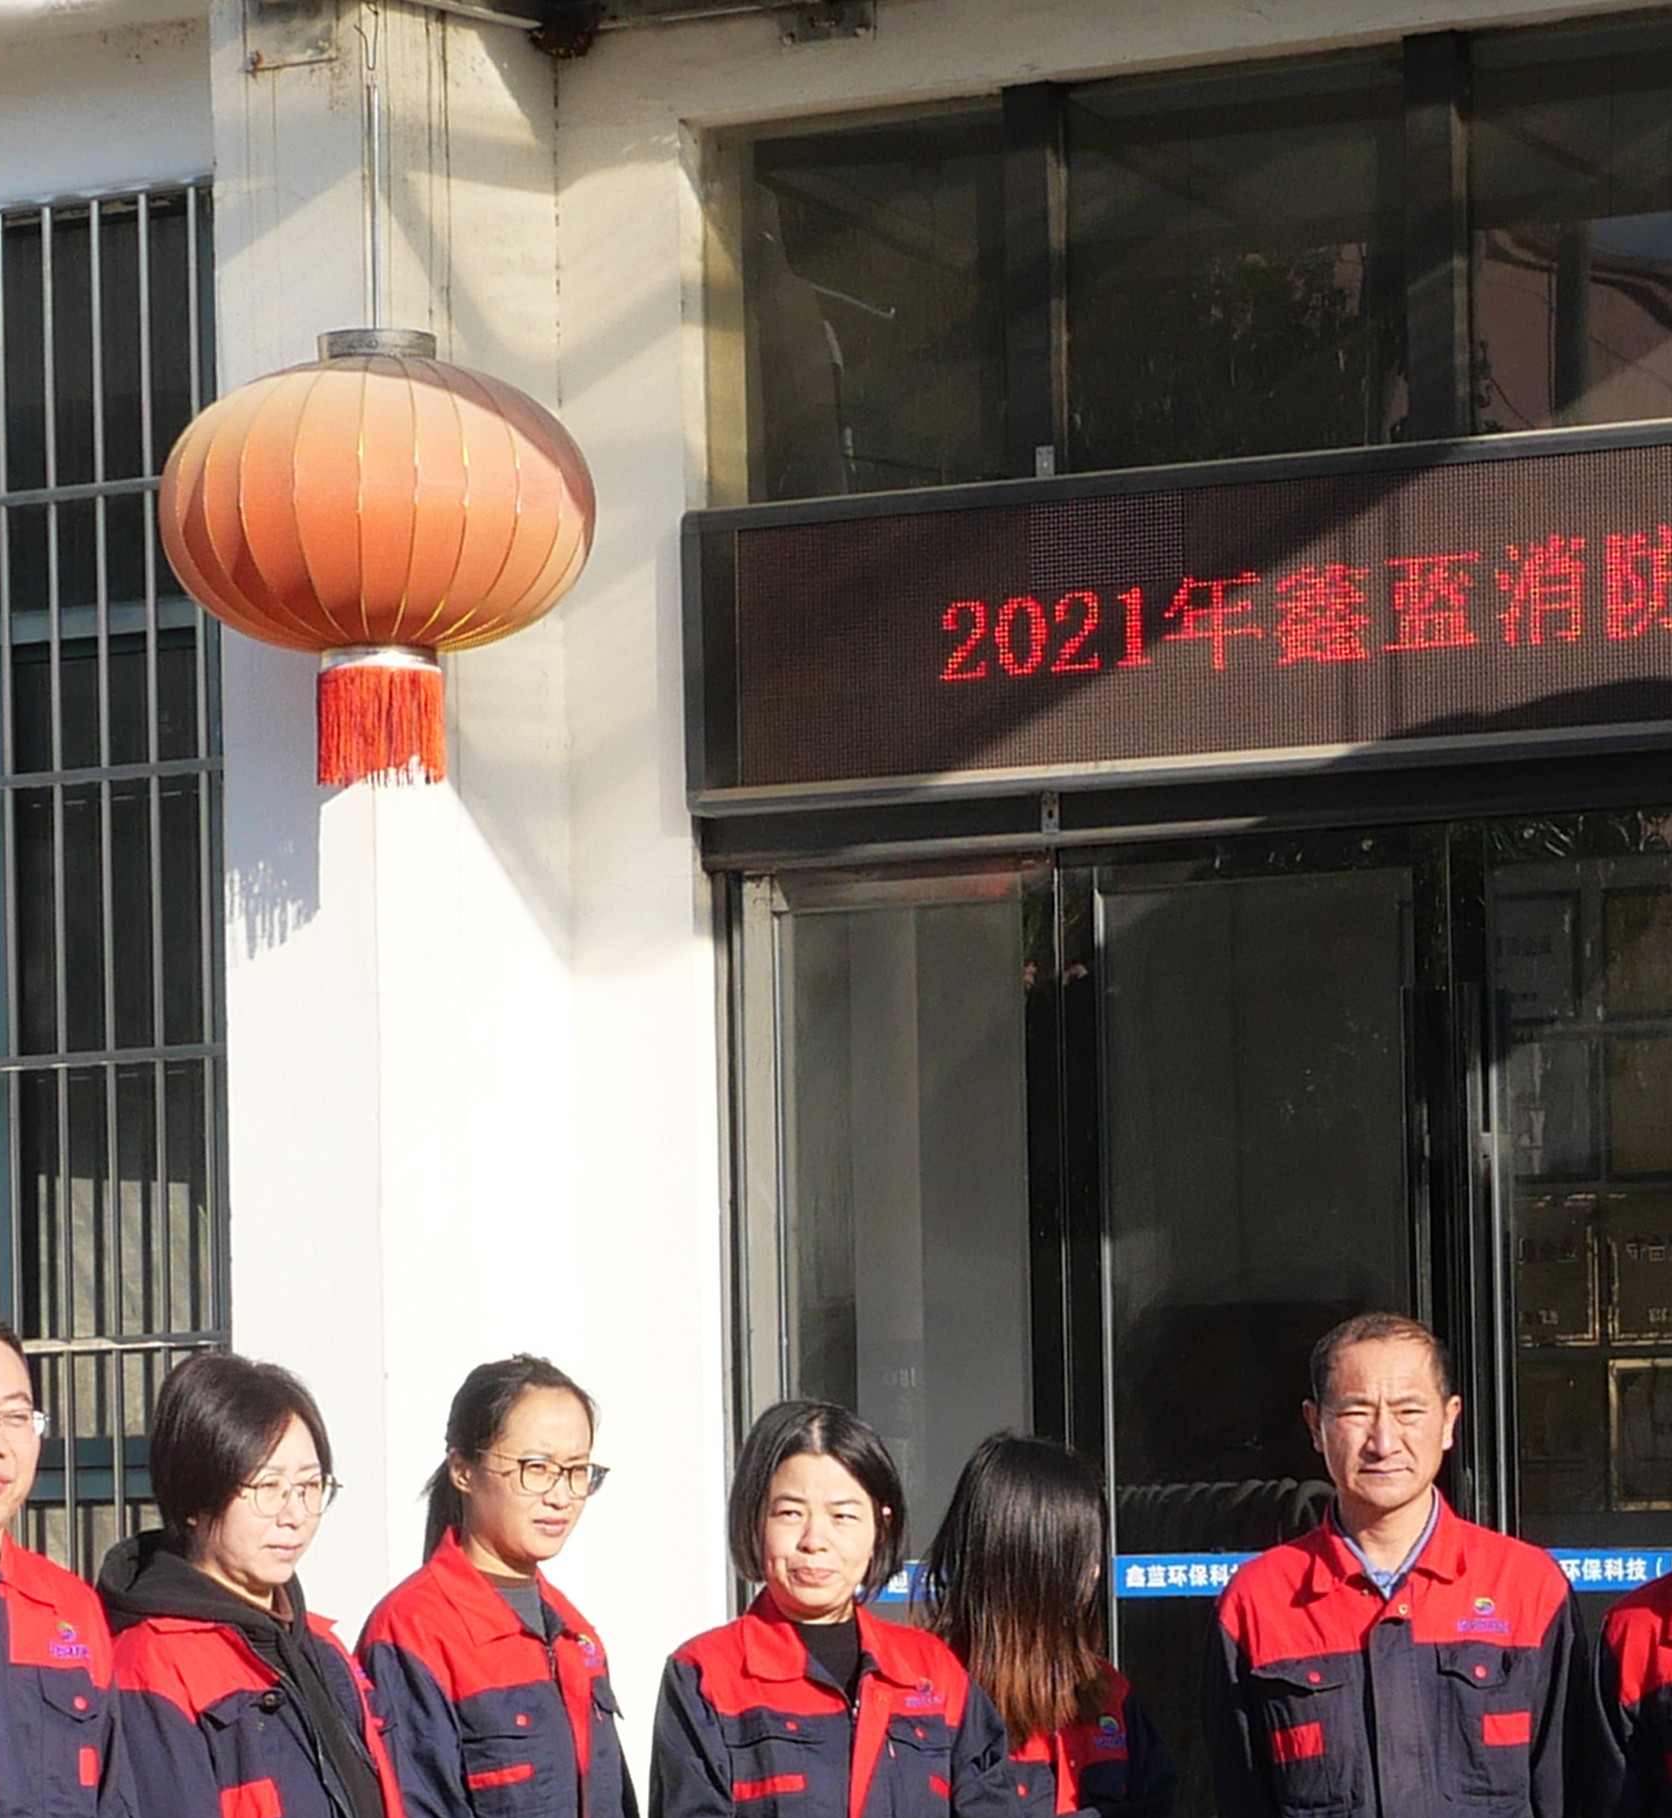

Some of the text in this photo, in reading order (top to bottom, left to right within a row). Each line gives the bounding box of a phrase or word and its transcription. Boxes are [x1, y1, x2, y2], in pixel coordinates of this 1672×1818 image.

[1126, 1563, 1238, 1588] 鑫蓝环保科
